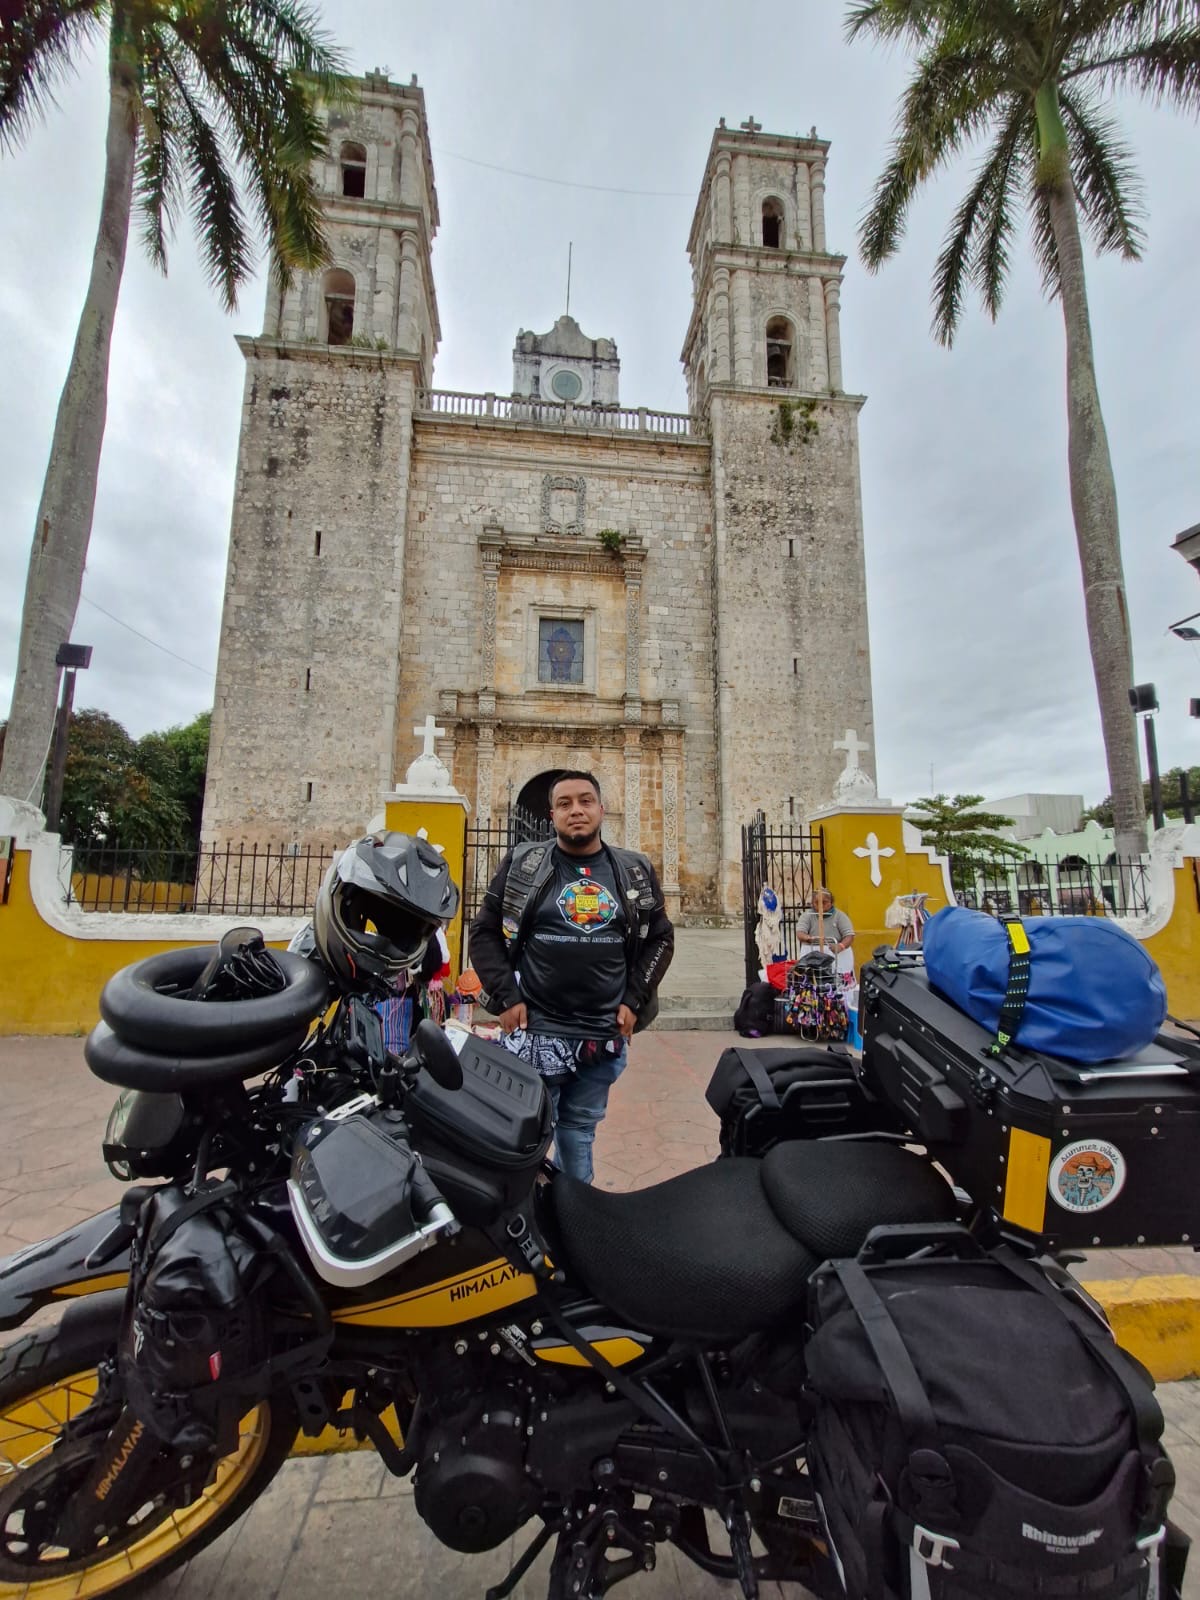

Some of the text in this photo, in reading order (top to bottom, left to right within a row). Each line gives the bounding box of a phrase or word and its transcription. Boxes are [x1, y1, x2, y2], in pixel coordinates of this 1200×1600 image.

[1061, 1143, 1098, 1163] summer
[450, 1265, 521, 1302] HIMALAY
[95, 1419, 145, 1500] HIMALAYAN
